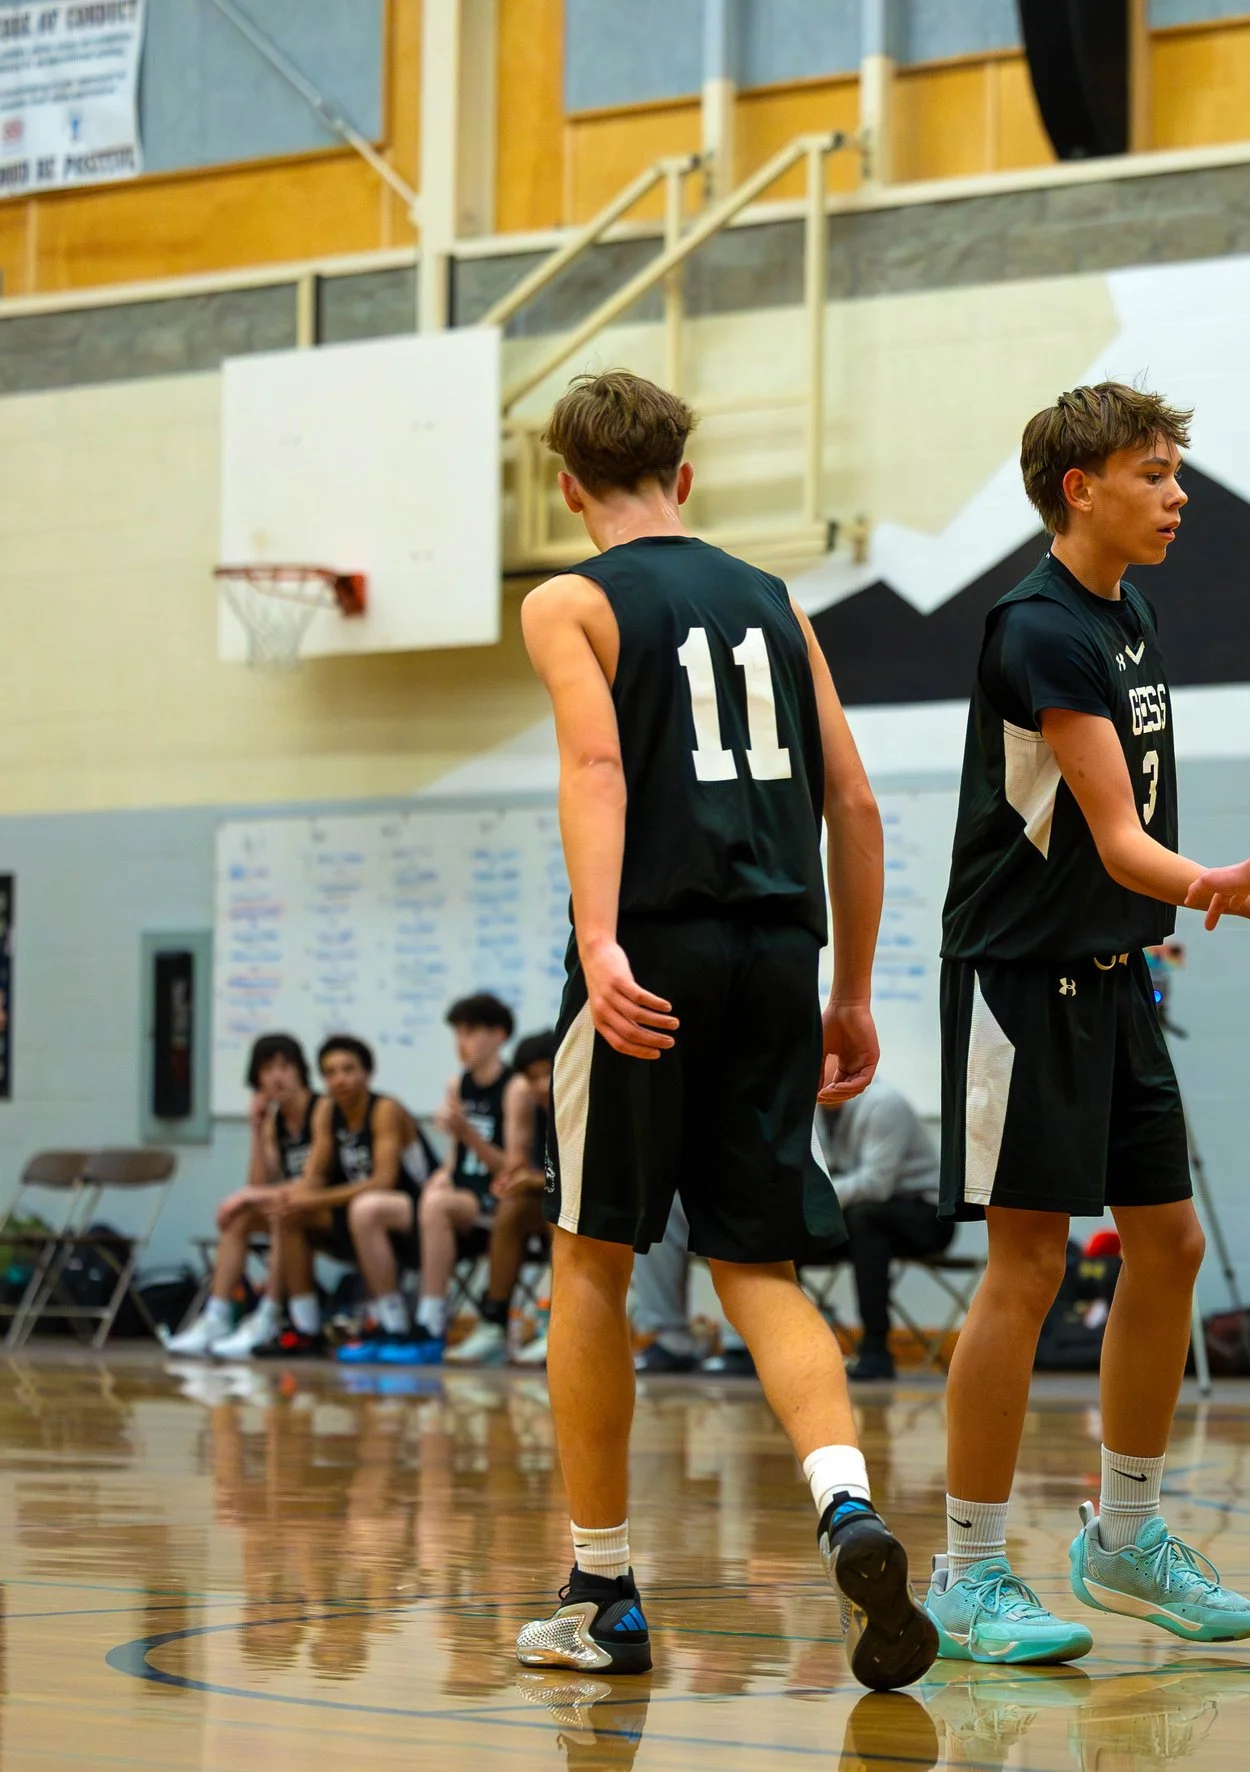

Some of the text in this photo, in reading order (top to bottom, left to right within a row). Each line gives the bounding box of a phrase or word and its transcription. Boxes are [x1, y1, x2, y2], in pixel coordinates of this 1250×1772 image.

[677, 627, 792, 781] 11
[1128, 683, 1167, 736] GESS
[1142, 750, 1160, 826] 3
